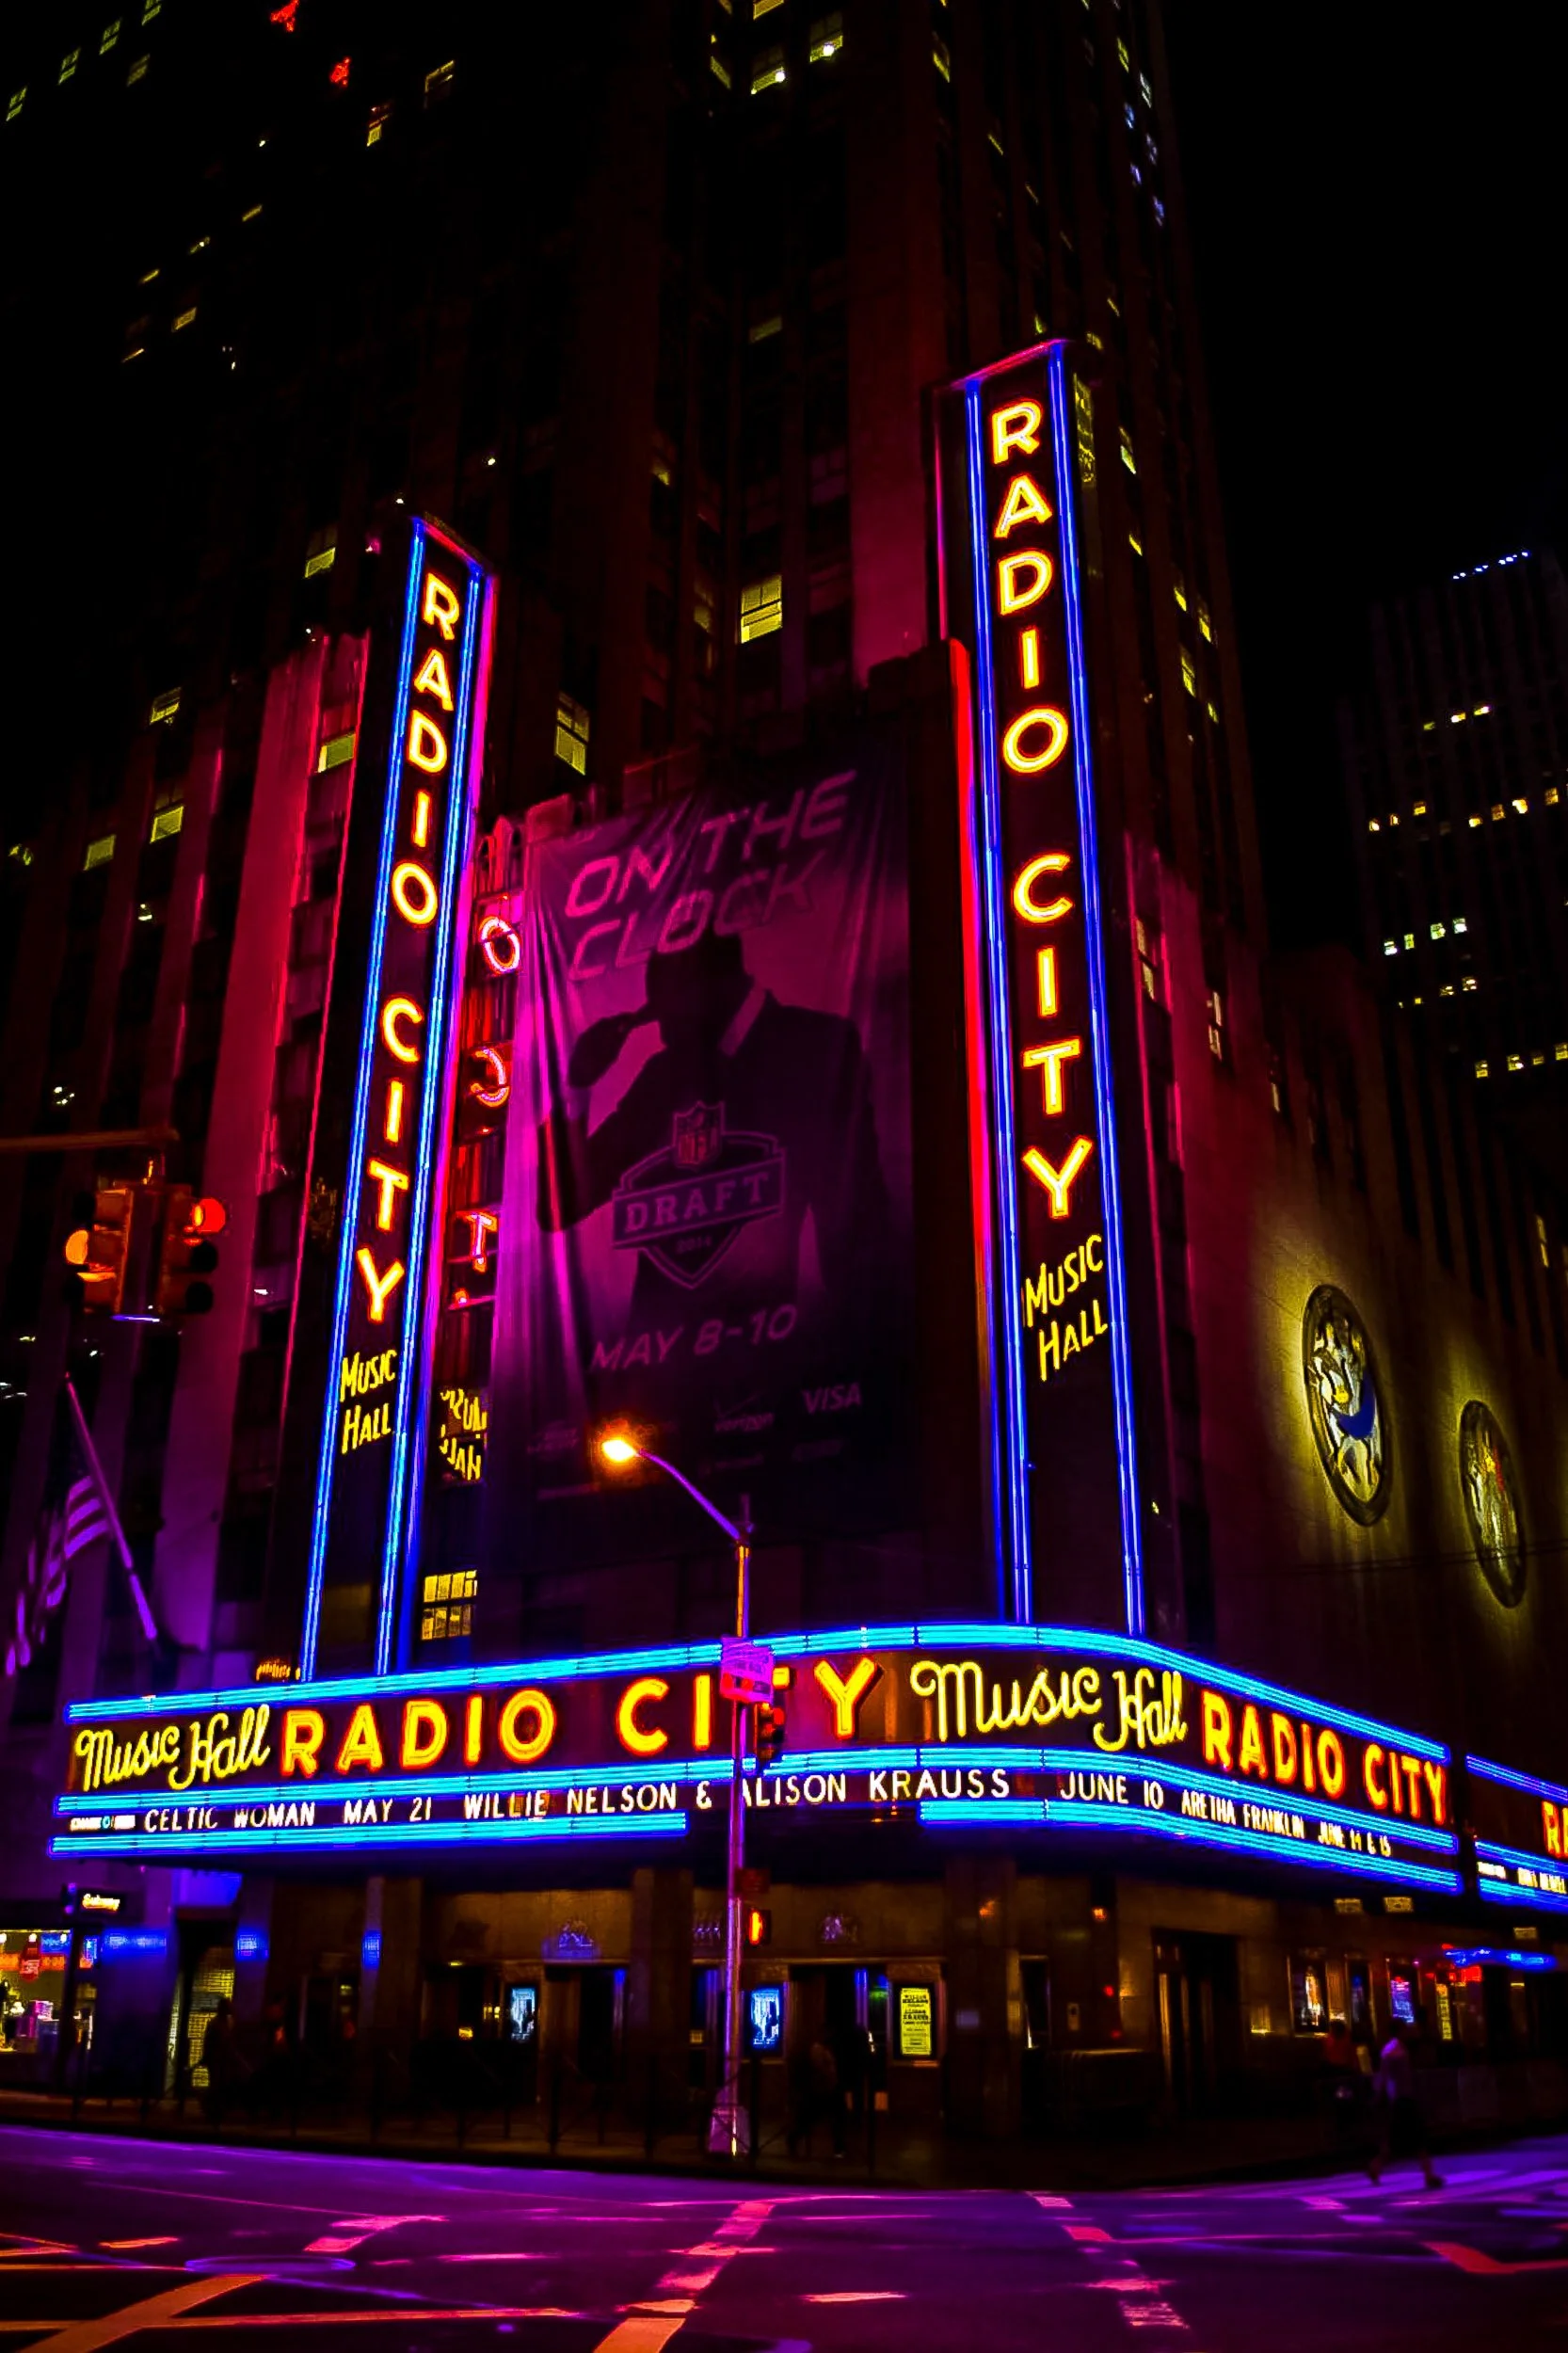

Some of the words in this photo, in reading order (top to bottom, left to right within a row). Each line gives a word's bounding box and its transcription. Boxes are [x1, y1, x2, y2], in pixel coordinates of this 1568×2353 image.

[991, 398, 1069, 775] RADIO
[391, 570, 461, 927] RADIO
[566, 845, 671, 918] ON
[700, 768, 857, 873] THE
[568, 849, 834, 982] CLOCK
[1013, 853, 1094, 1219] CITY
[355, 996, 424, 1322] CITY
[626, 1171, 770, 1233] DRAFT
[1024, 1234, 1104, 1328] MUSIC
[341, 1349, 396, 1401] MUSIC
[591, 1323, 684, 1371] MAY
[694, 1304, 798, 1356] 8-10
[1037, 1299, 1108, 1382] HALL
[342, 1402, 395, 1455] HALL
[802, 1381, 862, 1416] VISA
[74, 1724, 181, 1792] Music
[168, 1704, 271, 1790] Hall
[281, 1689, 556, 1777] RADIO
[616, 1657, 877, 1757] CIY
[910, 1660, 1102, 1742] Music
[1093, 1667, 1189, 1752] Hall
[464, 1789, 548, 1819] WILLIE
[567, 1783, 677, 1815] NELSON
[696, 1780, 712, 1809] &
[869, 1769, 1010, 1801] KRAUSS
[1060, 1770, 1129, 1804] JUNE
[1144, 1780, 1164, 1810] 10
[1201, 1689, 1345, 1799] RADIO
[1363, 1743, 1447, 1826] CITY
[144, 1806, 218, 1833] CELTIC
[234, 1801, 315, 1828] WOMAN
[344, 1799, 392, 1824] MAY
[409, 1797, 432, 1821] 21
[1181, 1789, 1236, 1825] ARETHA
[1242, 1803, 1305, 1839] FRANKLIN
[1319, 1821, 1346, 1849] JUNE
